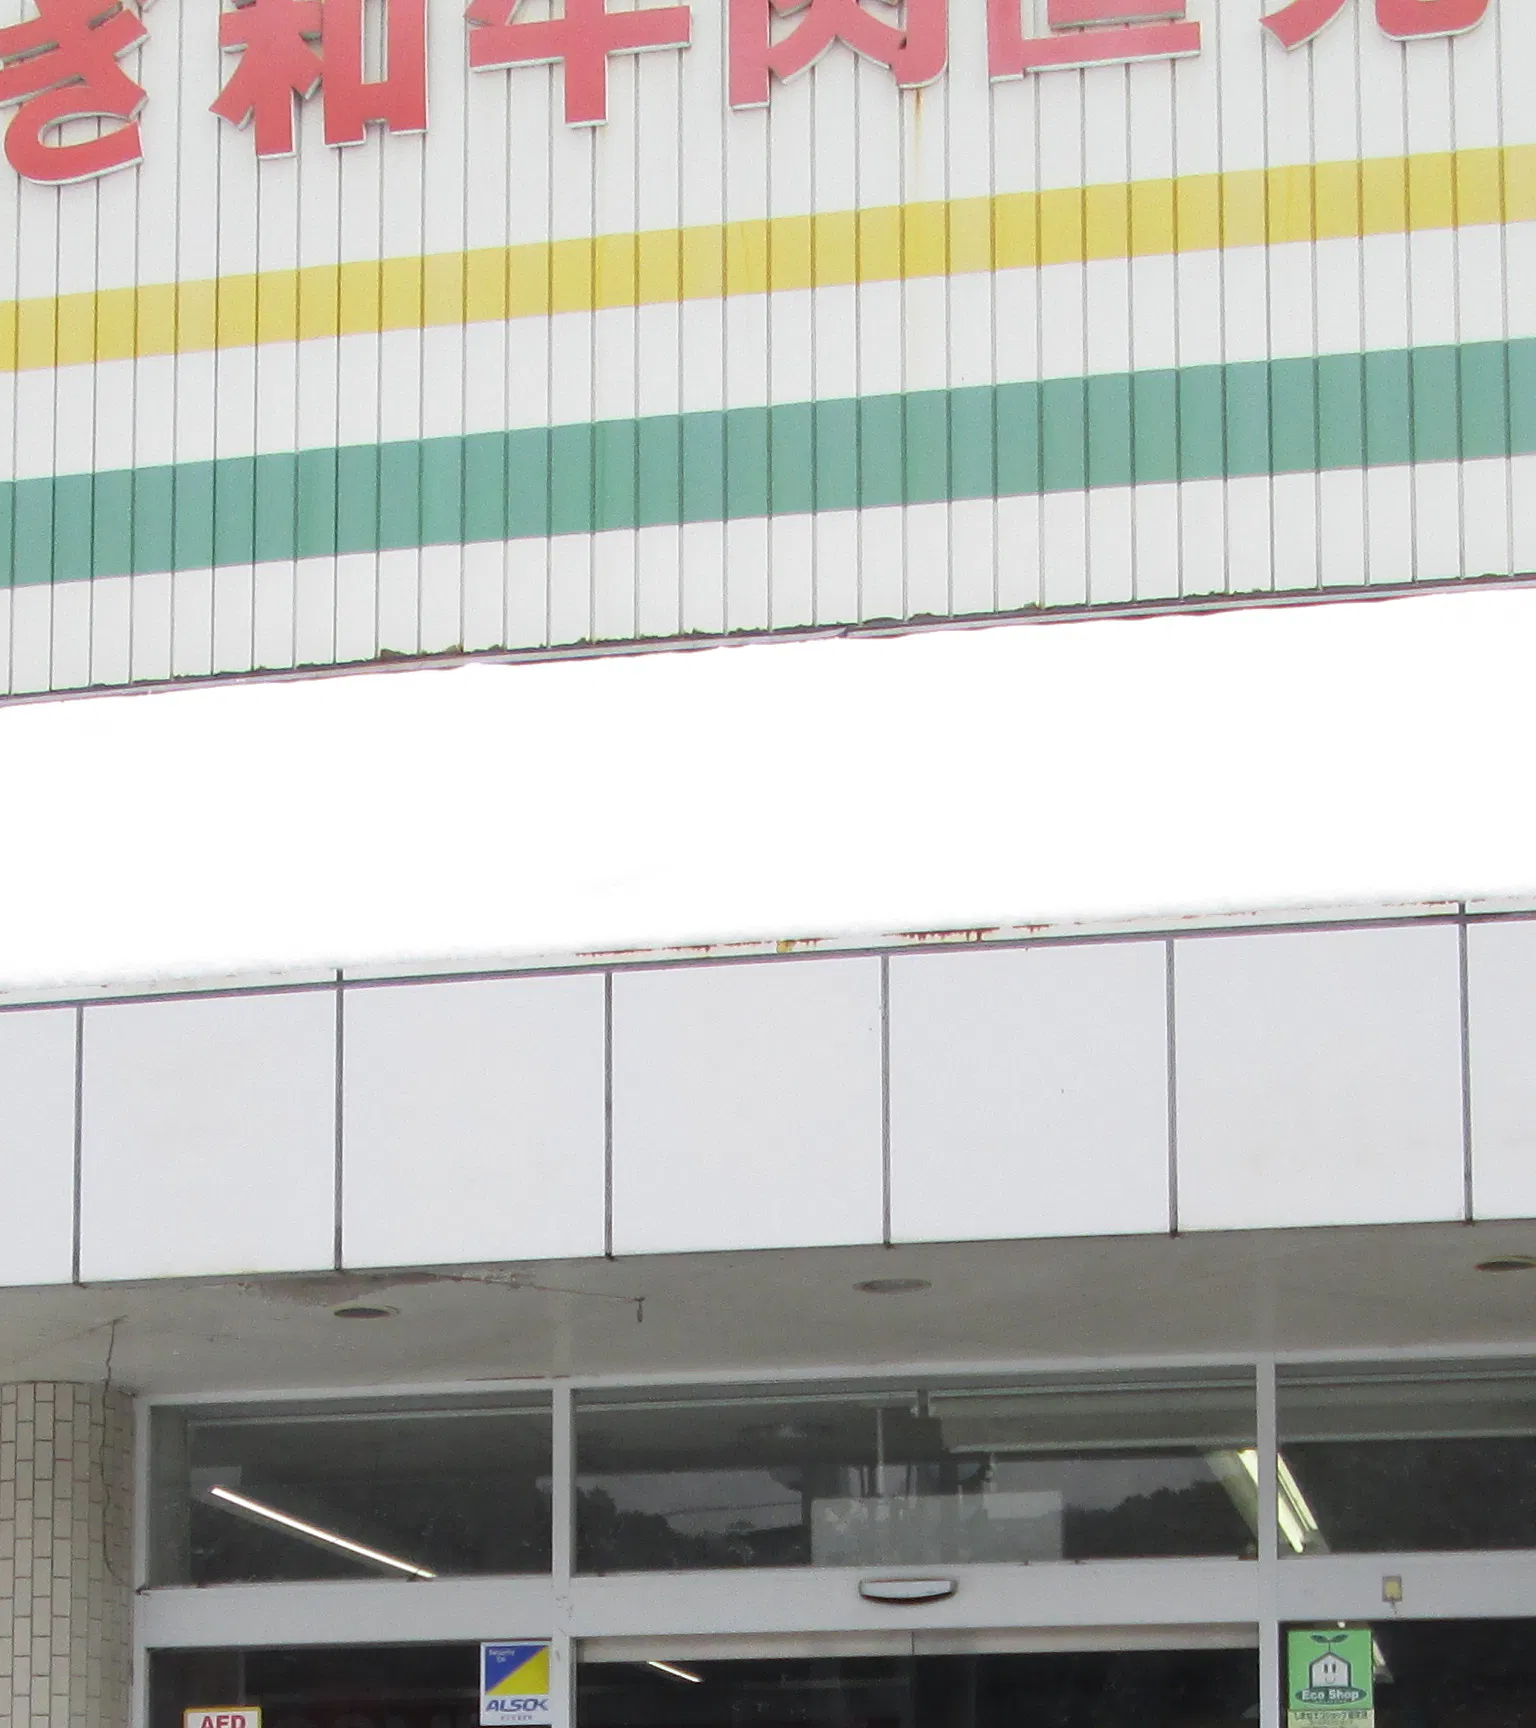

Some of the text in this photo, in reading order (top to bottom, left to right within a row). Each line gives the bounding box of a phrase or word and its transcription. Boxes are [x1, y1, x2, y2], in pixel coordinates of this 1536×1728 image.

[1301, 1688, 1360, 1701] Eco Shop
[485, 1698, 549, 1712] ALSOK
